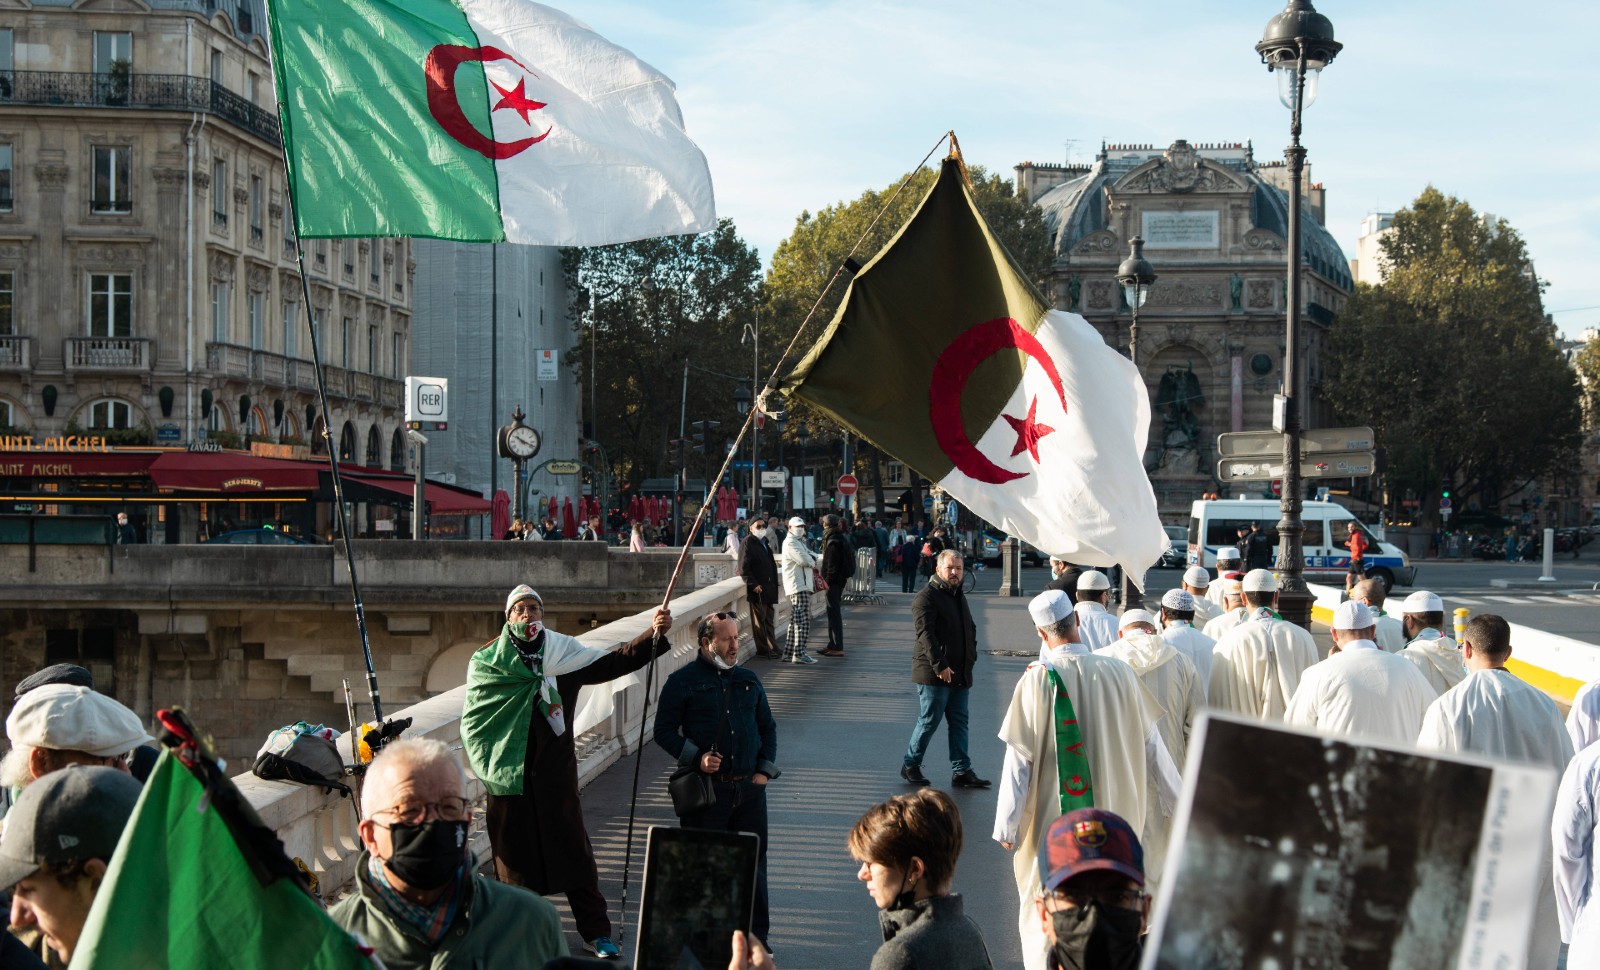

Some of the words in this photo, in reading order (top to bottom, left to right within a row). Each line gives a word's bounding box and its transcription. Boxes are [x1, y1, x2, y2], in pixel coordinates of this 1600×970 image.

[421, 394, 440, 406] RER
[190, 442, 223, 452] LAVAZZA
[32, 464, 75, 475] MICHEL
[1491, 786, 1510, 828] Paris
